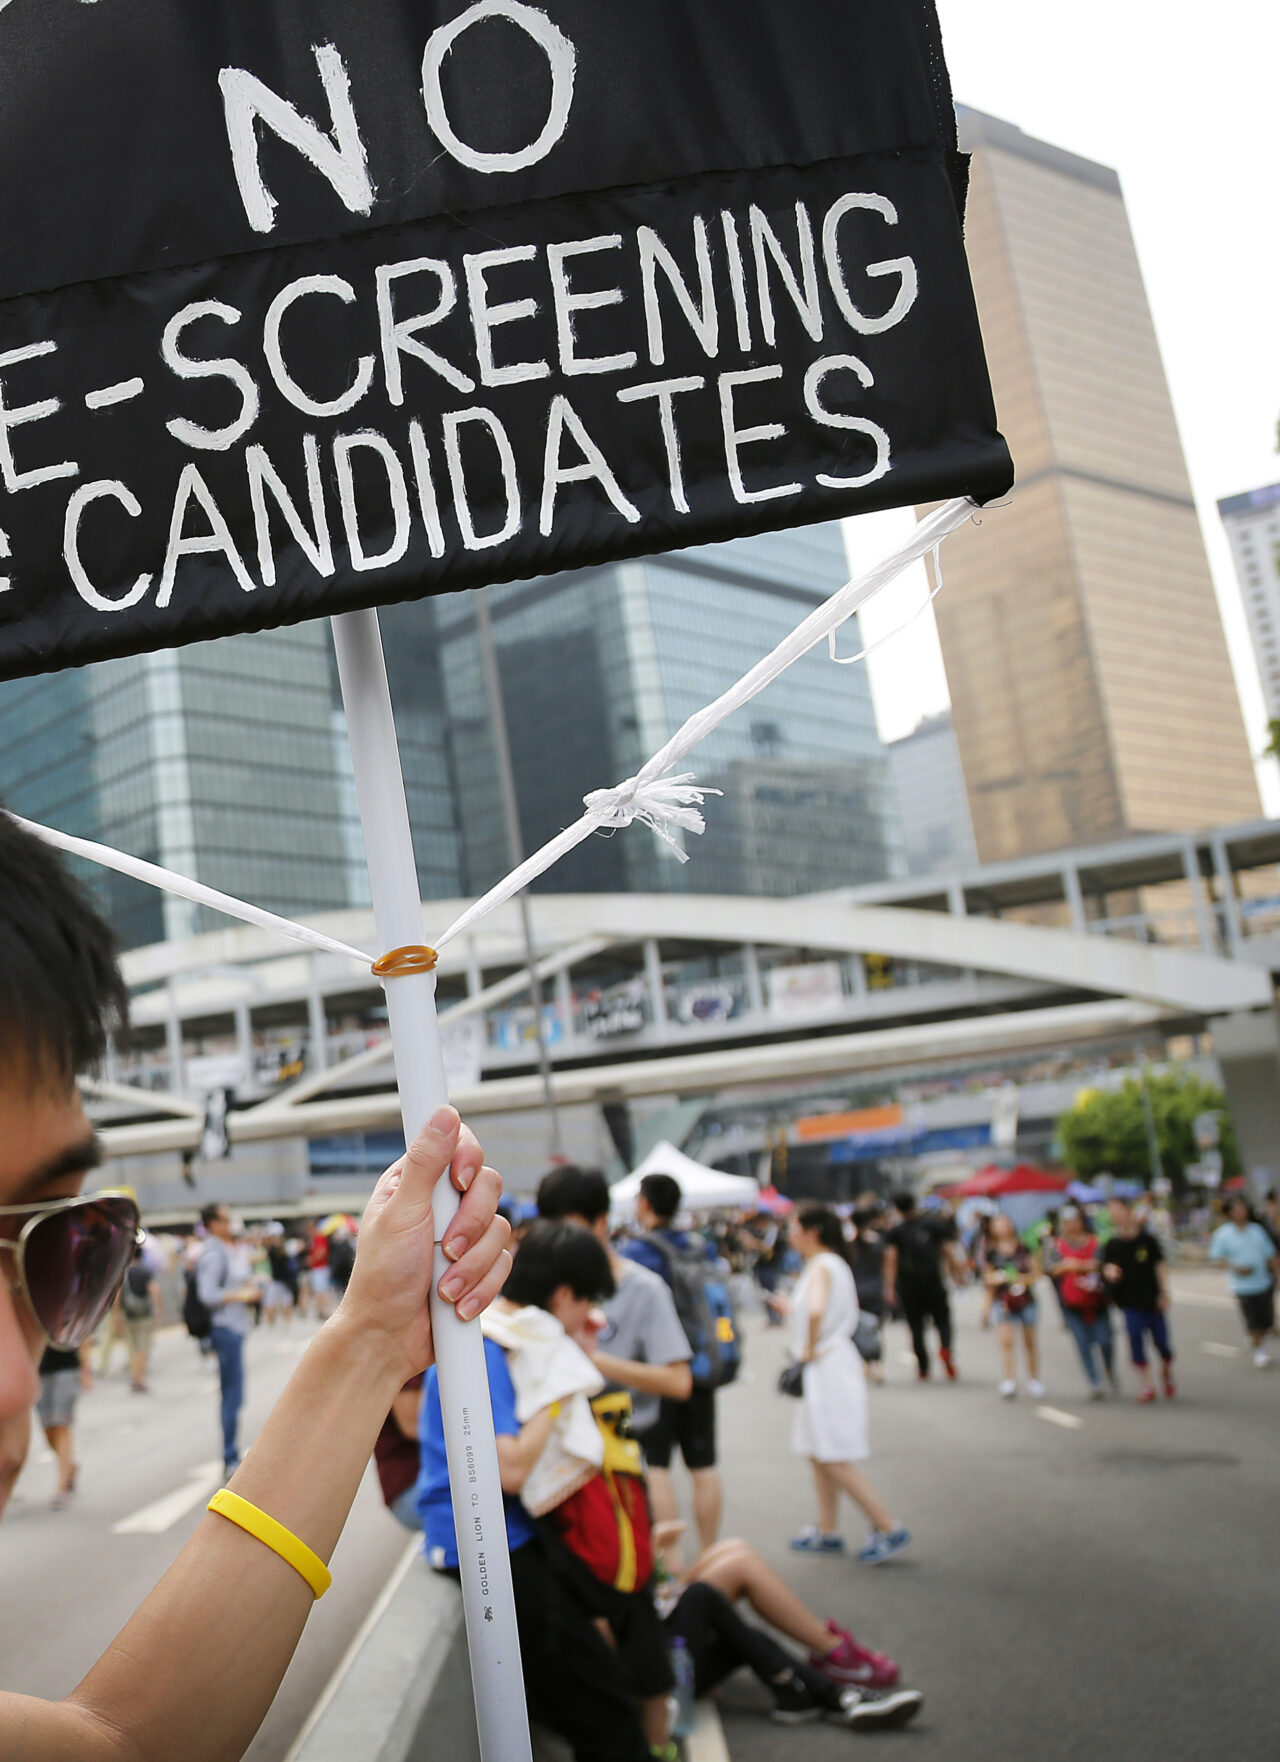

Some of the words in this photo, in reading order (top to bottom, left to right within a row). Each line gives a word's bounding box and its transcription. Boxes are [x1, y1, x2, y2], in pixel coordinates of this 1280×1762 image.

[218, 0, 576, 234] NO
[64, 355, 893, 611] CANDIDATES
[462, 1407, 471, 1436] 25mm
[466, 1445, 477, 1483] BS6099
[471, 1493, 480, 1508] TO
[474, 1517, 483, 1542] LION
[478, 1552, 489, 1596] GOLDEN
